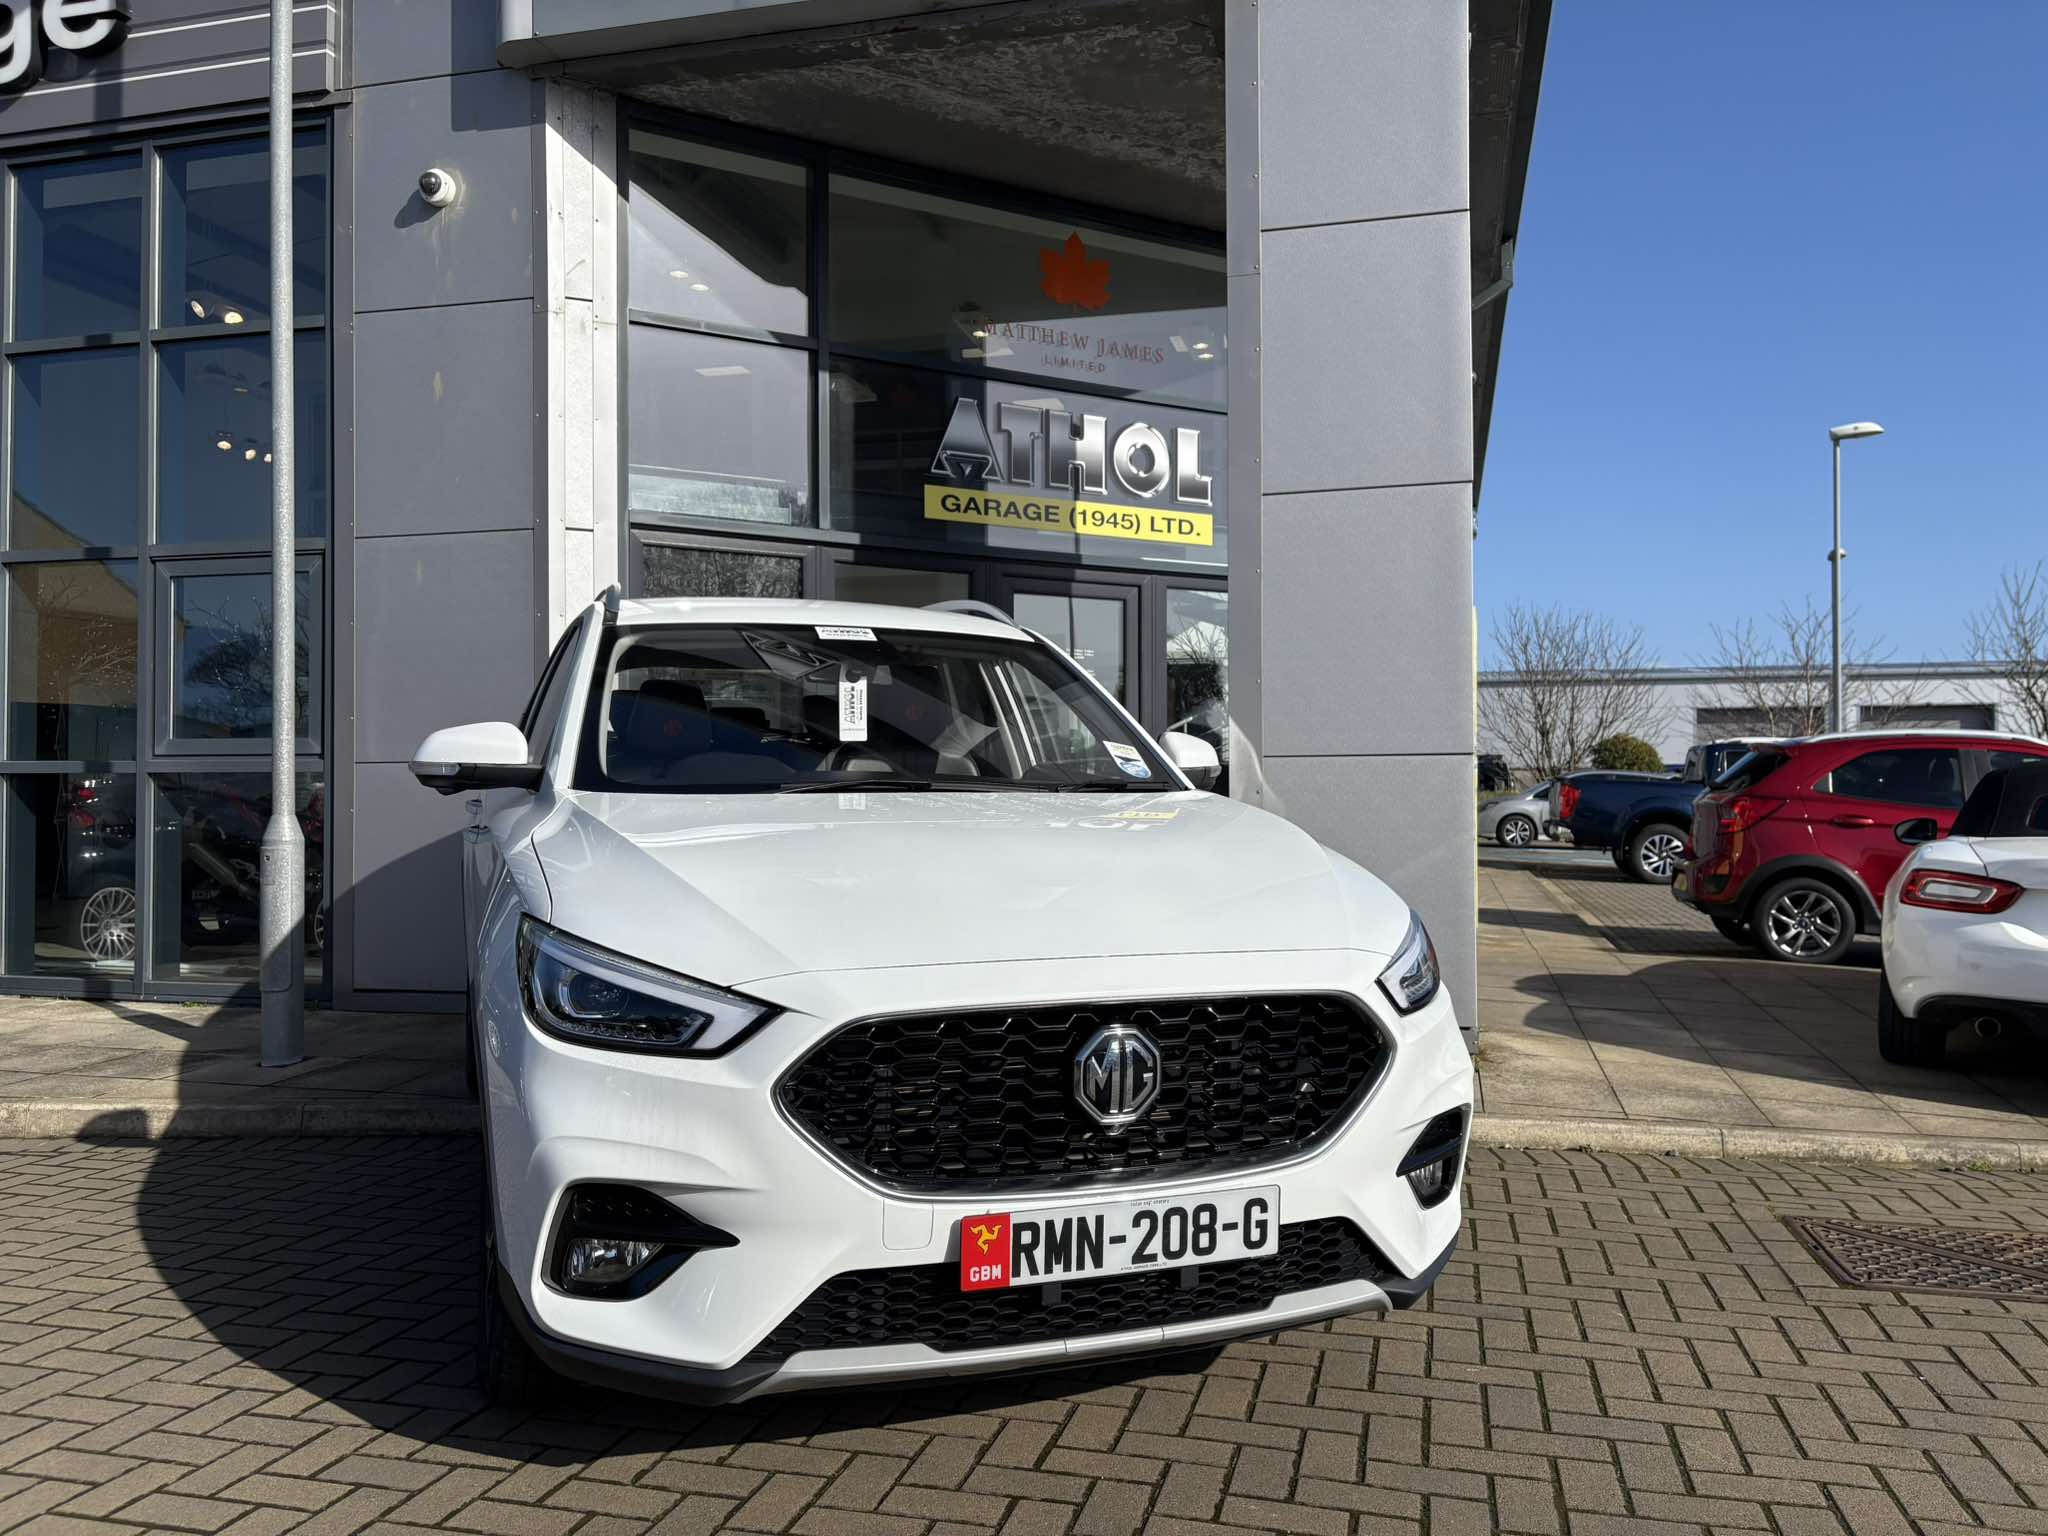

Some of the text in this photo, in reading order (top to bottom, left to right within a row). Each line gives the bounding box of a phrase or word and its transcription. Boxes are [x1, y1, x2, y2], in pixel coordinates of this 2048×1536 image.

[983, 321, 1164, 364] MATTHEW JAMES
[1041, 354, 1105, 373] LIMITED
[930, 397, 1212, 506] ATHOL
[940, 494, 1201, 537] GARAGE (1945) LTD.
[1086, 1039, 1154, 1113] MG
[1011, 1197, 1269, 1278] RMN-208-G
[970, 1264, 1002, 1282] GBM
